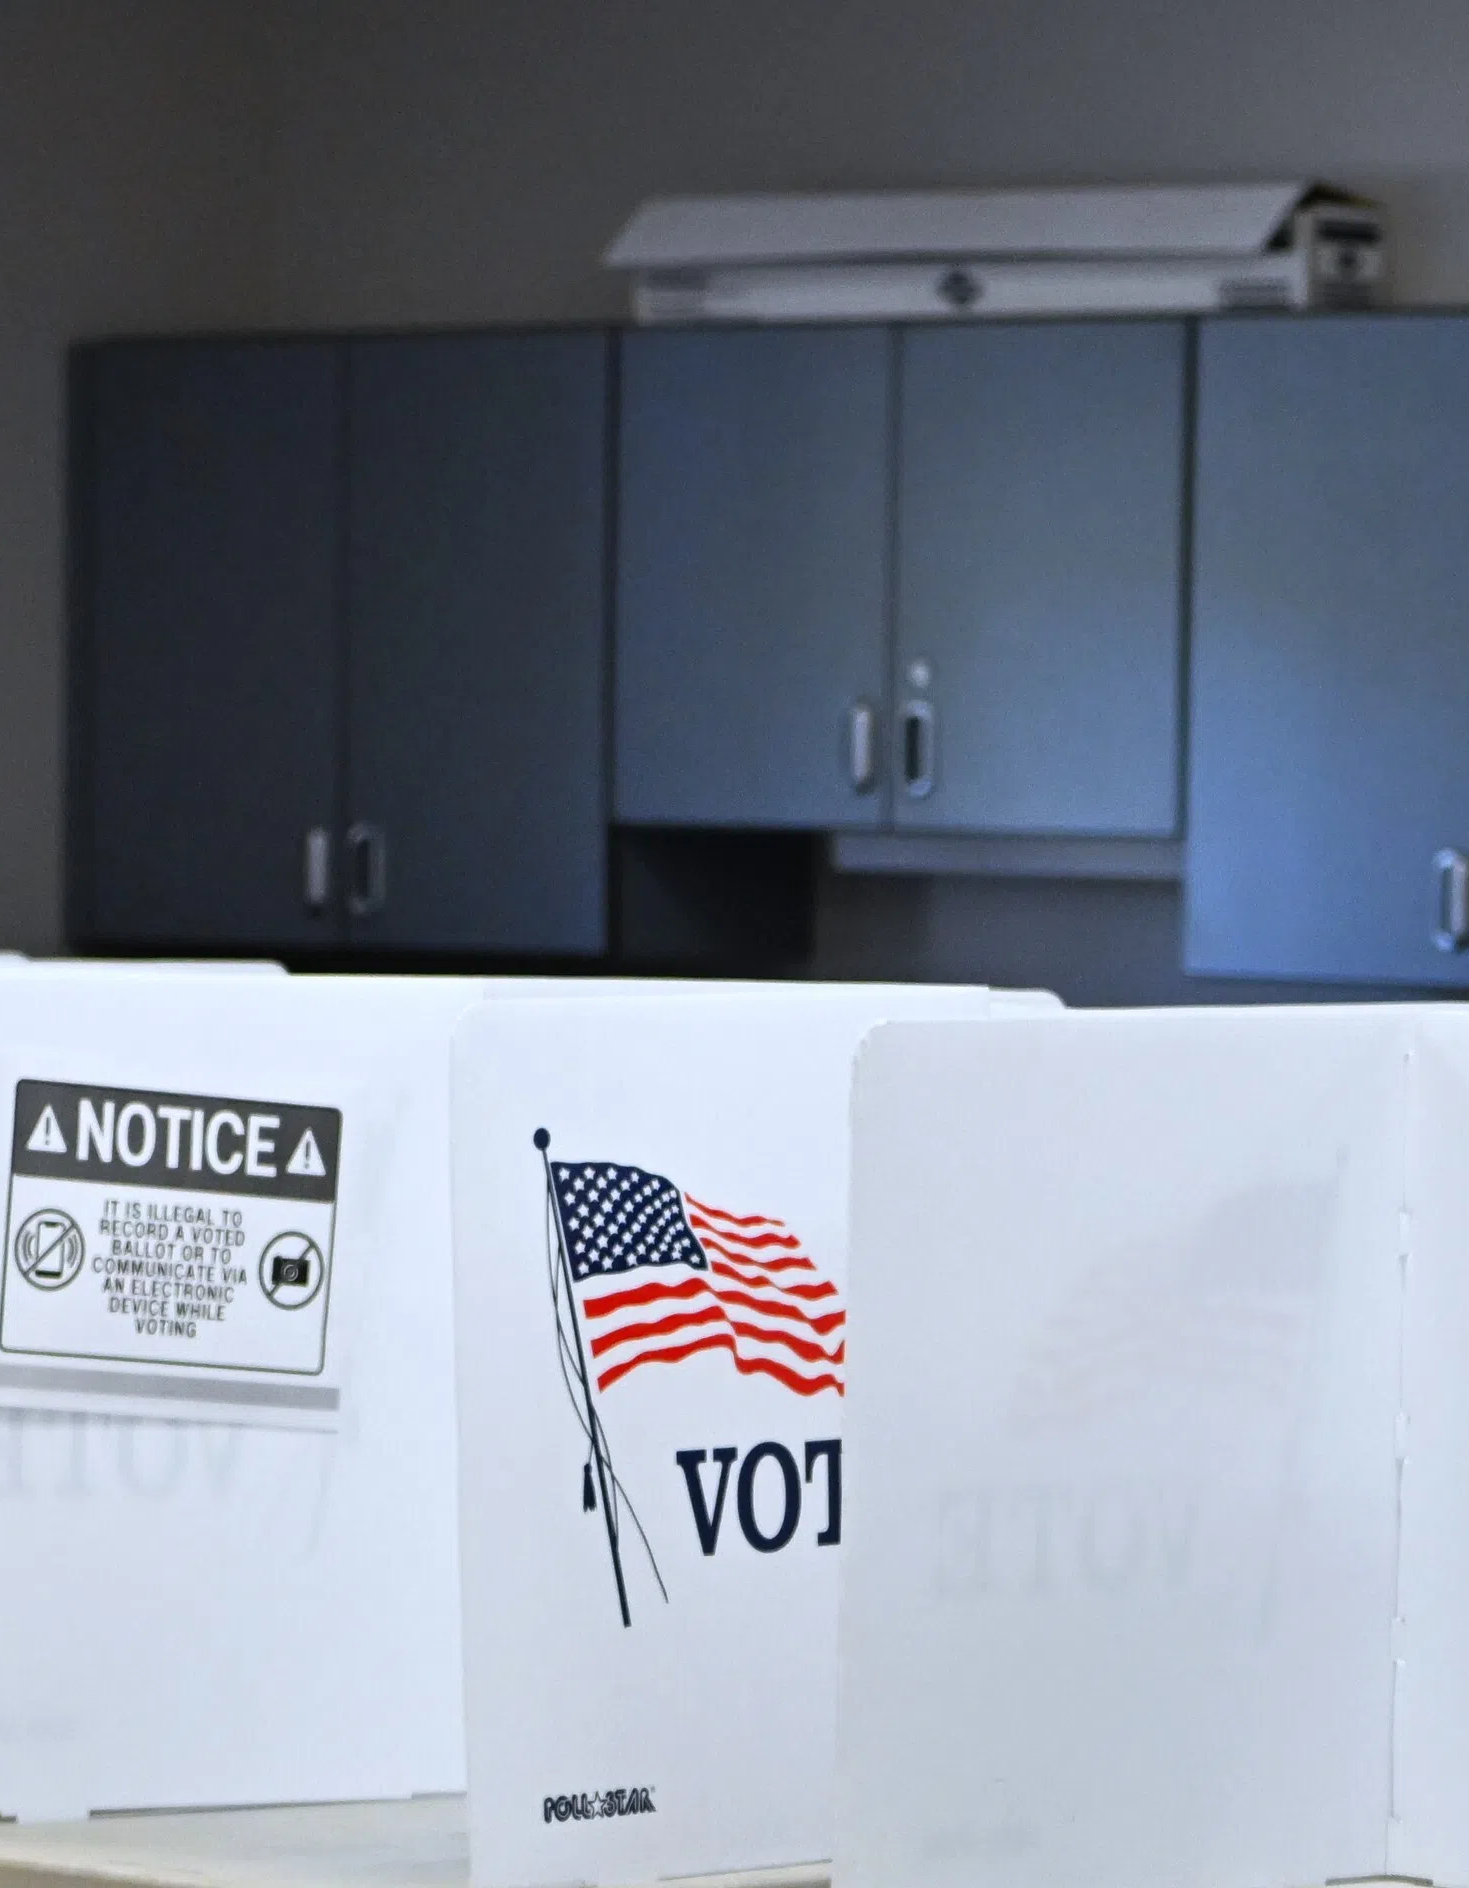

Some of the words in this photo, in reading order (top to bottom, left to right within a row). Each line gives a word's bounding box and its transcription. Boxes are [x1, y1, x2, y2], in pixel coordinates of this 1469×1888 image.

[76, 1098, 280, 1178] NOTICE
[104, 1200, 119, 1214] IT
[125, 1202, 141, 1219] IS
[147, 1204, 214, 1225] ILLEGAL
[222, 1210, 243, 1228] TO
[99, 1219, 168, 1240] RECORD
[175, 1226, 184, 1241] A
[192, 1228, 245, 1246] VOTED
[111, 1239, 176, 1260] BALLOT
[182, 1246, 204, 1262] OR
[211, 1248, 232, 1265] TO
[92, 1257, 214, 1282] COMMUNICATE
[222, 1268, 247, 1285] VIA
[103, 1277, 125, 1293] AN
[132, 1280, 235, 1303] ELECTRONIC
[109, 1297, 168, 1317] DEVICE
[176, 1302, 226, 1321] WHILE
[135, 1319, 197, 1338] VOTING
[676, 1439, 843, 1556] VOT
